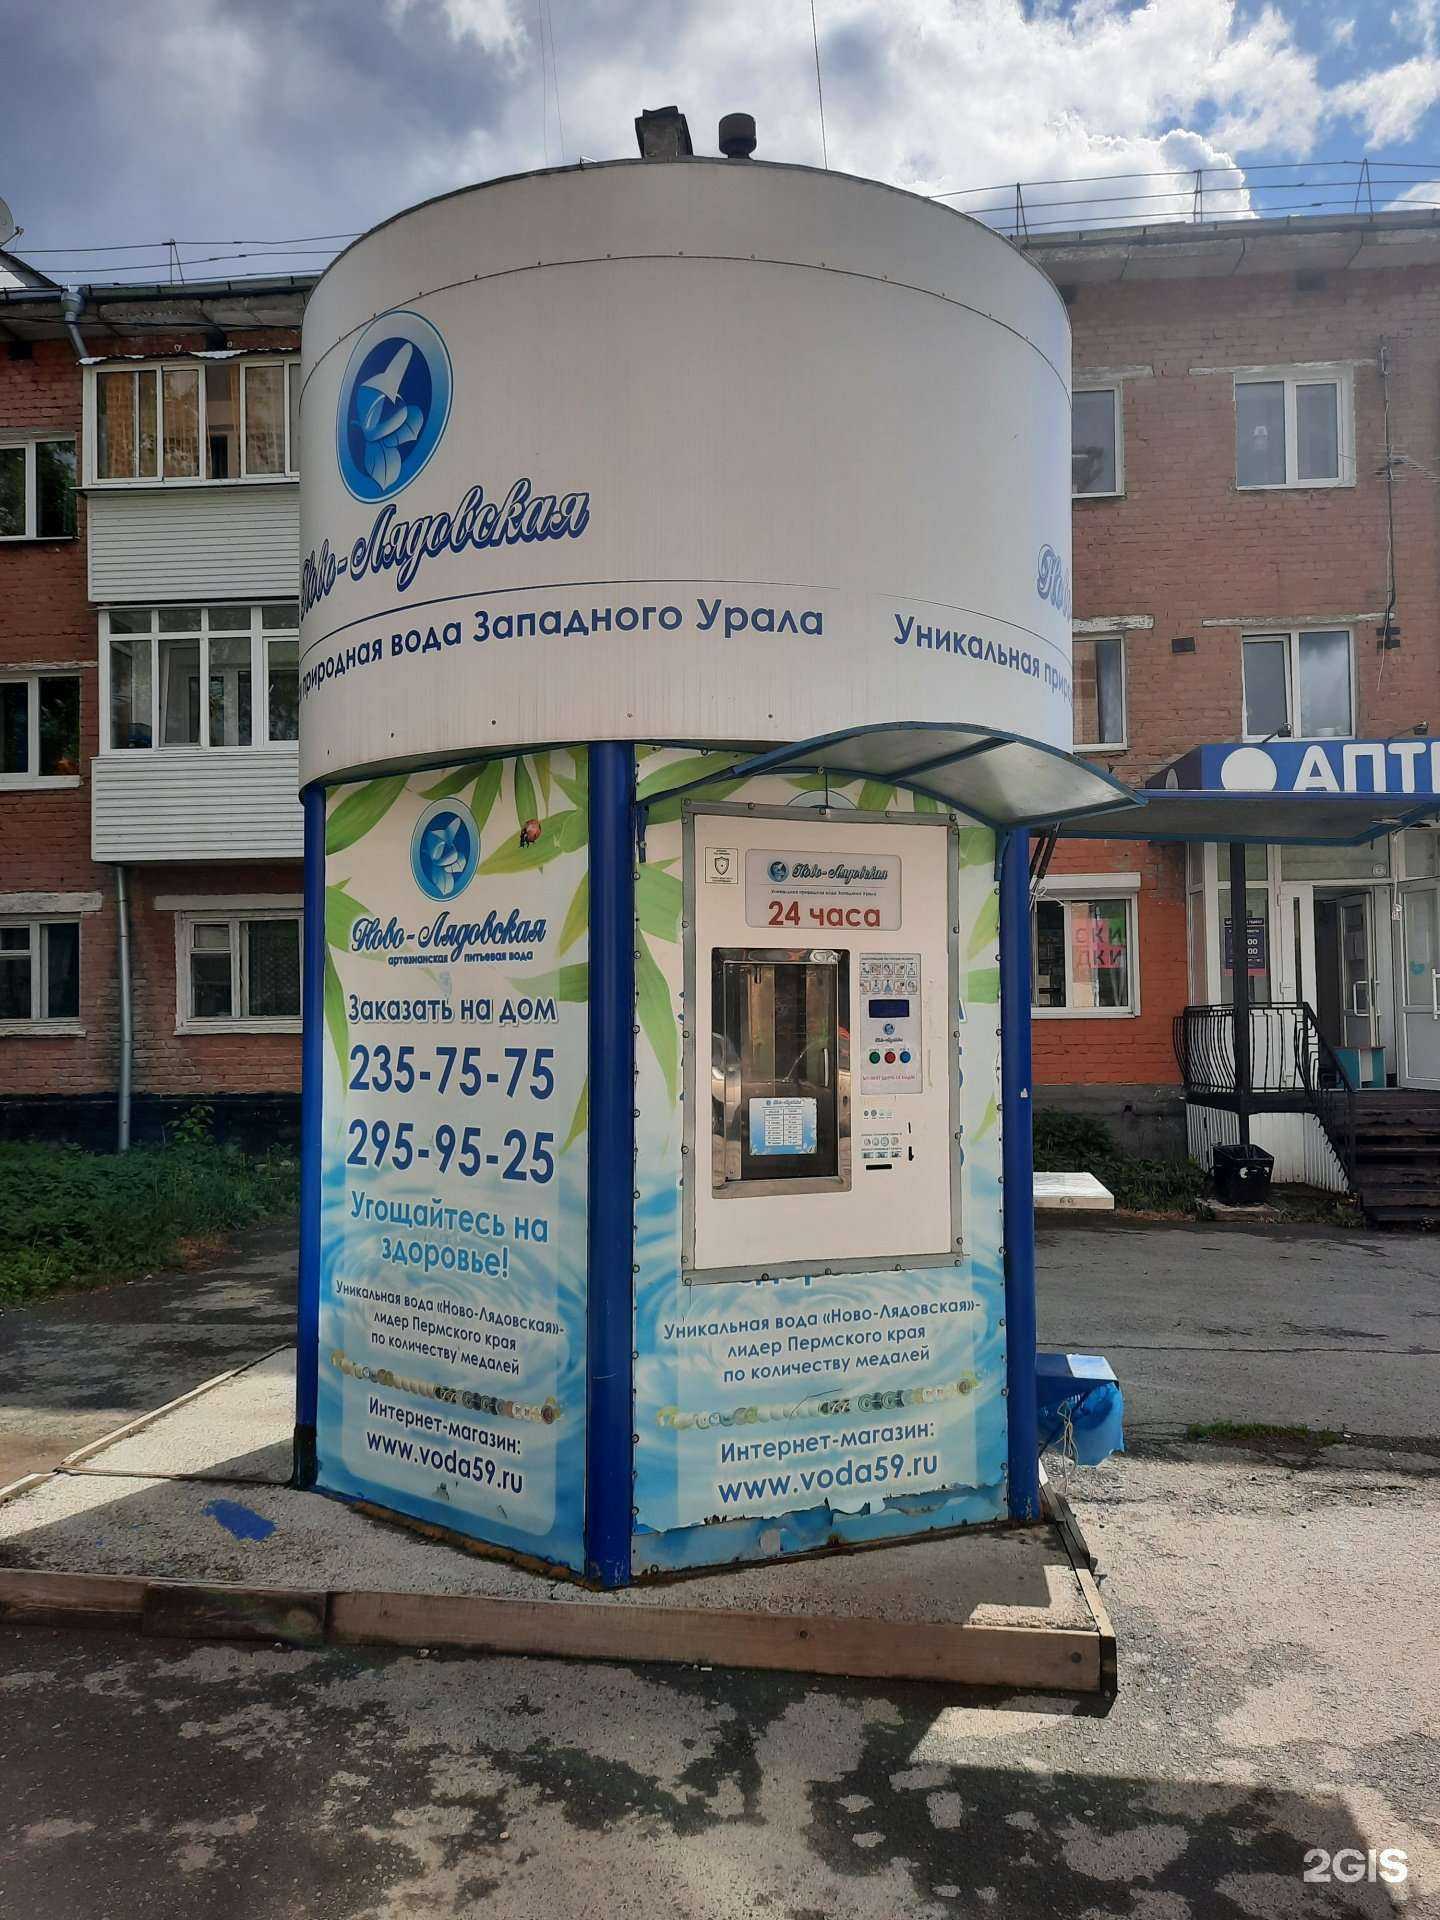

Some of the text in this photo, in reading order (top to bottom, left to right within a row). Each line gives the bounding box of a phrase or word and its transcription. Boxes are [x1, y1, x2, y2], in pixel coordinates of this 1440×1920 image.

[391, 621, 462, 657] вода
[473, 606, 683, 642] Западного
[696, 598, 824, 638] Урала
[894, 614, 1040, 679] Уникальная
[1293, 742, 1440, 794] АПТ
[352, 908, 546, 962] Ново-Лядовская
[769, 901, 880, 927] 24 часа
[464, 952, 506, 963] питьевая
[509, 950, 533, 962] вода
[349, 994, 557, 1025] Заказать на дом
[349, 1044, 555, 1100] 235-75-75
[347, 1118, 555, 1184] 295-95-25
[351, 1190, 548, 1243] Угощайтесь на
[381, 1237, 509, 1279] здоровье!
[336, 1280, 401, 1305] Уникальная
[404, 1296, 434, 1312] вода
[374, 1312, 517, 1351] лидер Пермского края
[664, 1317, 770, 1340] Уникальная
[776, 1313, 818, 1330] вода
[728, 1326, 926, 1359] лидер Пермского края
[371, 1332, 520, 1376] по количеству медалей
[724, 1345, 930, 1383] по количеству медалей
[369, 1397, 522, 1455] Интернет-магазин:
[721, 1422, 935, 1465] Интернет-магазин:
[367, 1432, 523, 1494] www.voda59.ru
[718, 1453, 938, 1504] www.voda59.ru
